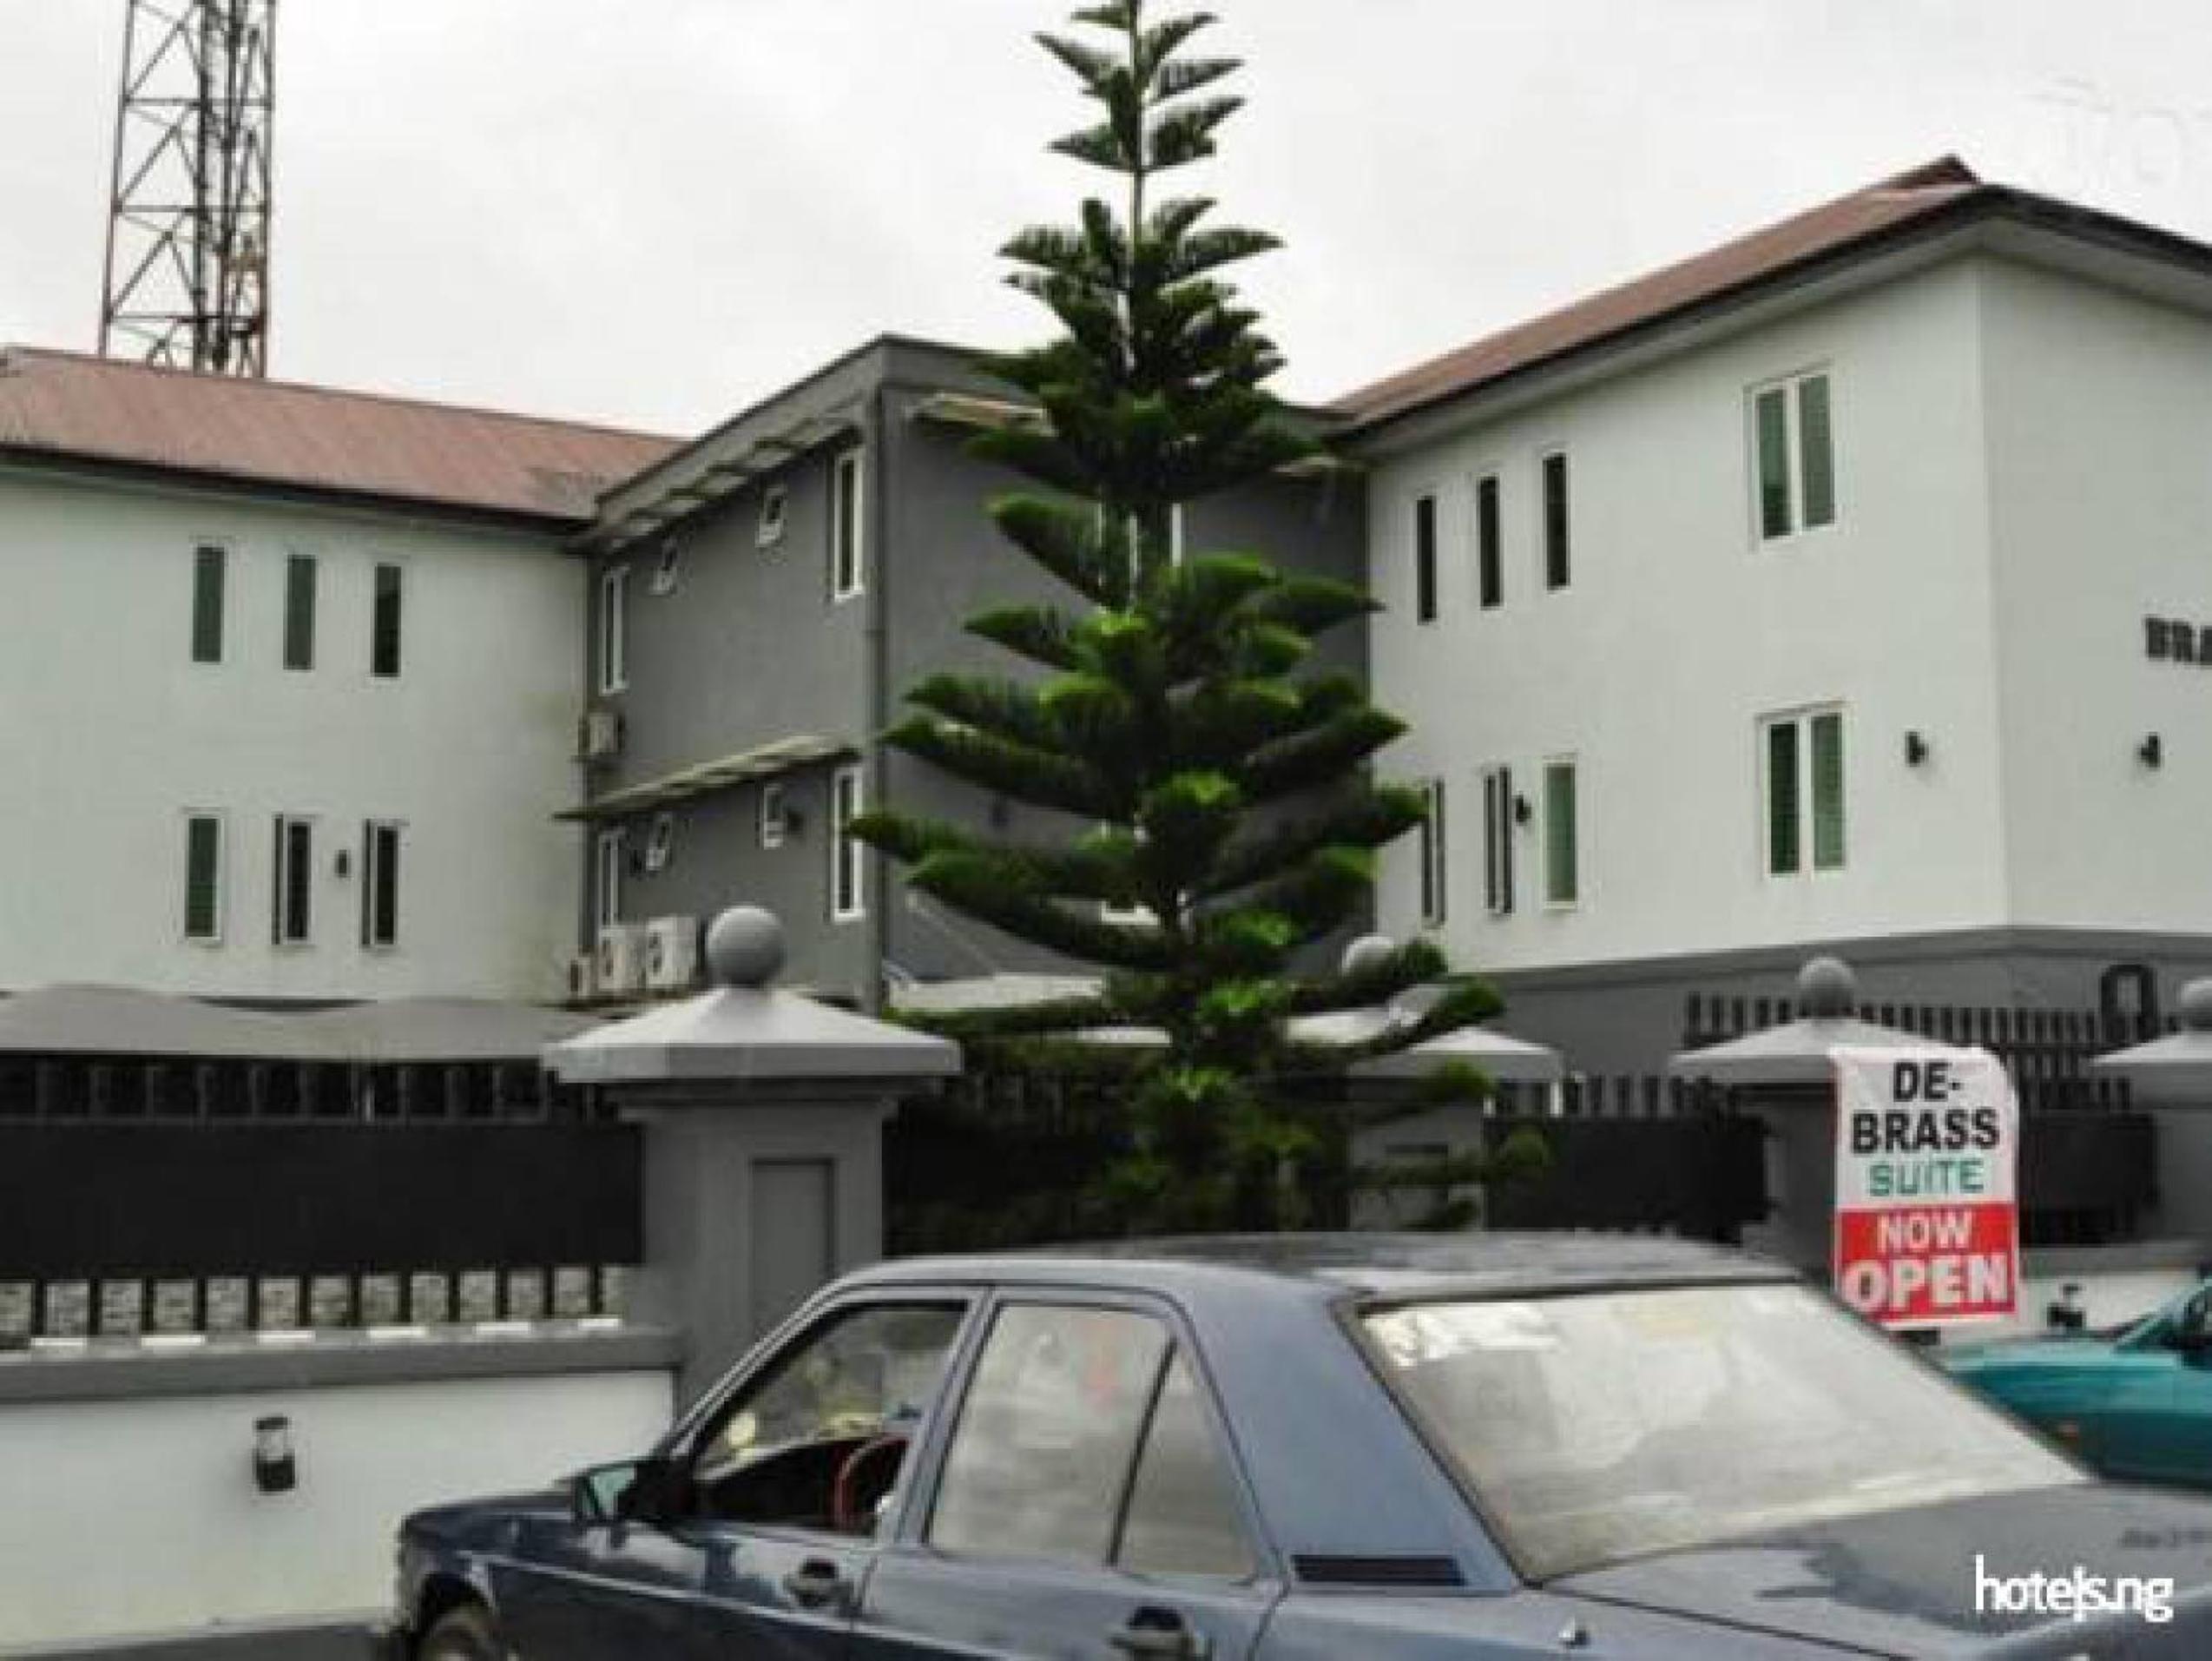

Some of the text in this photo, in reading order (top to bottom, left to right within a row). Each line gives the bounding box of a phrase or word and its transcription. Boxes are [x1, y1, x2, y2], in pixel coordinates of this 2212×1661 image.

[1893, 1062, 1961, 1102] DE-
[1852, 1107, 1999, 1153] BRASS
[1869, 1159, 1985, 1196] SUITE
[1877, 1210, 1972, 1253] NOW
[1843, 1254, 2008, 1312] OPEN
